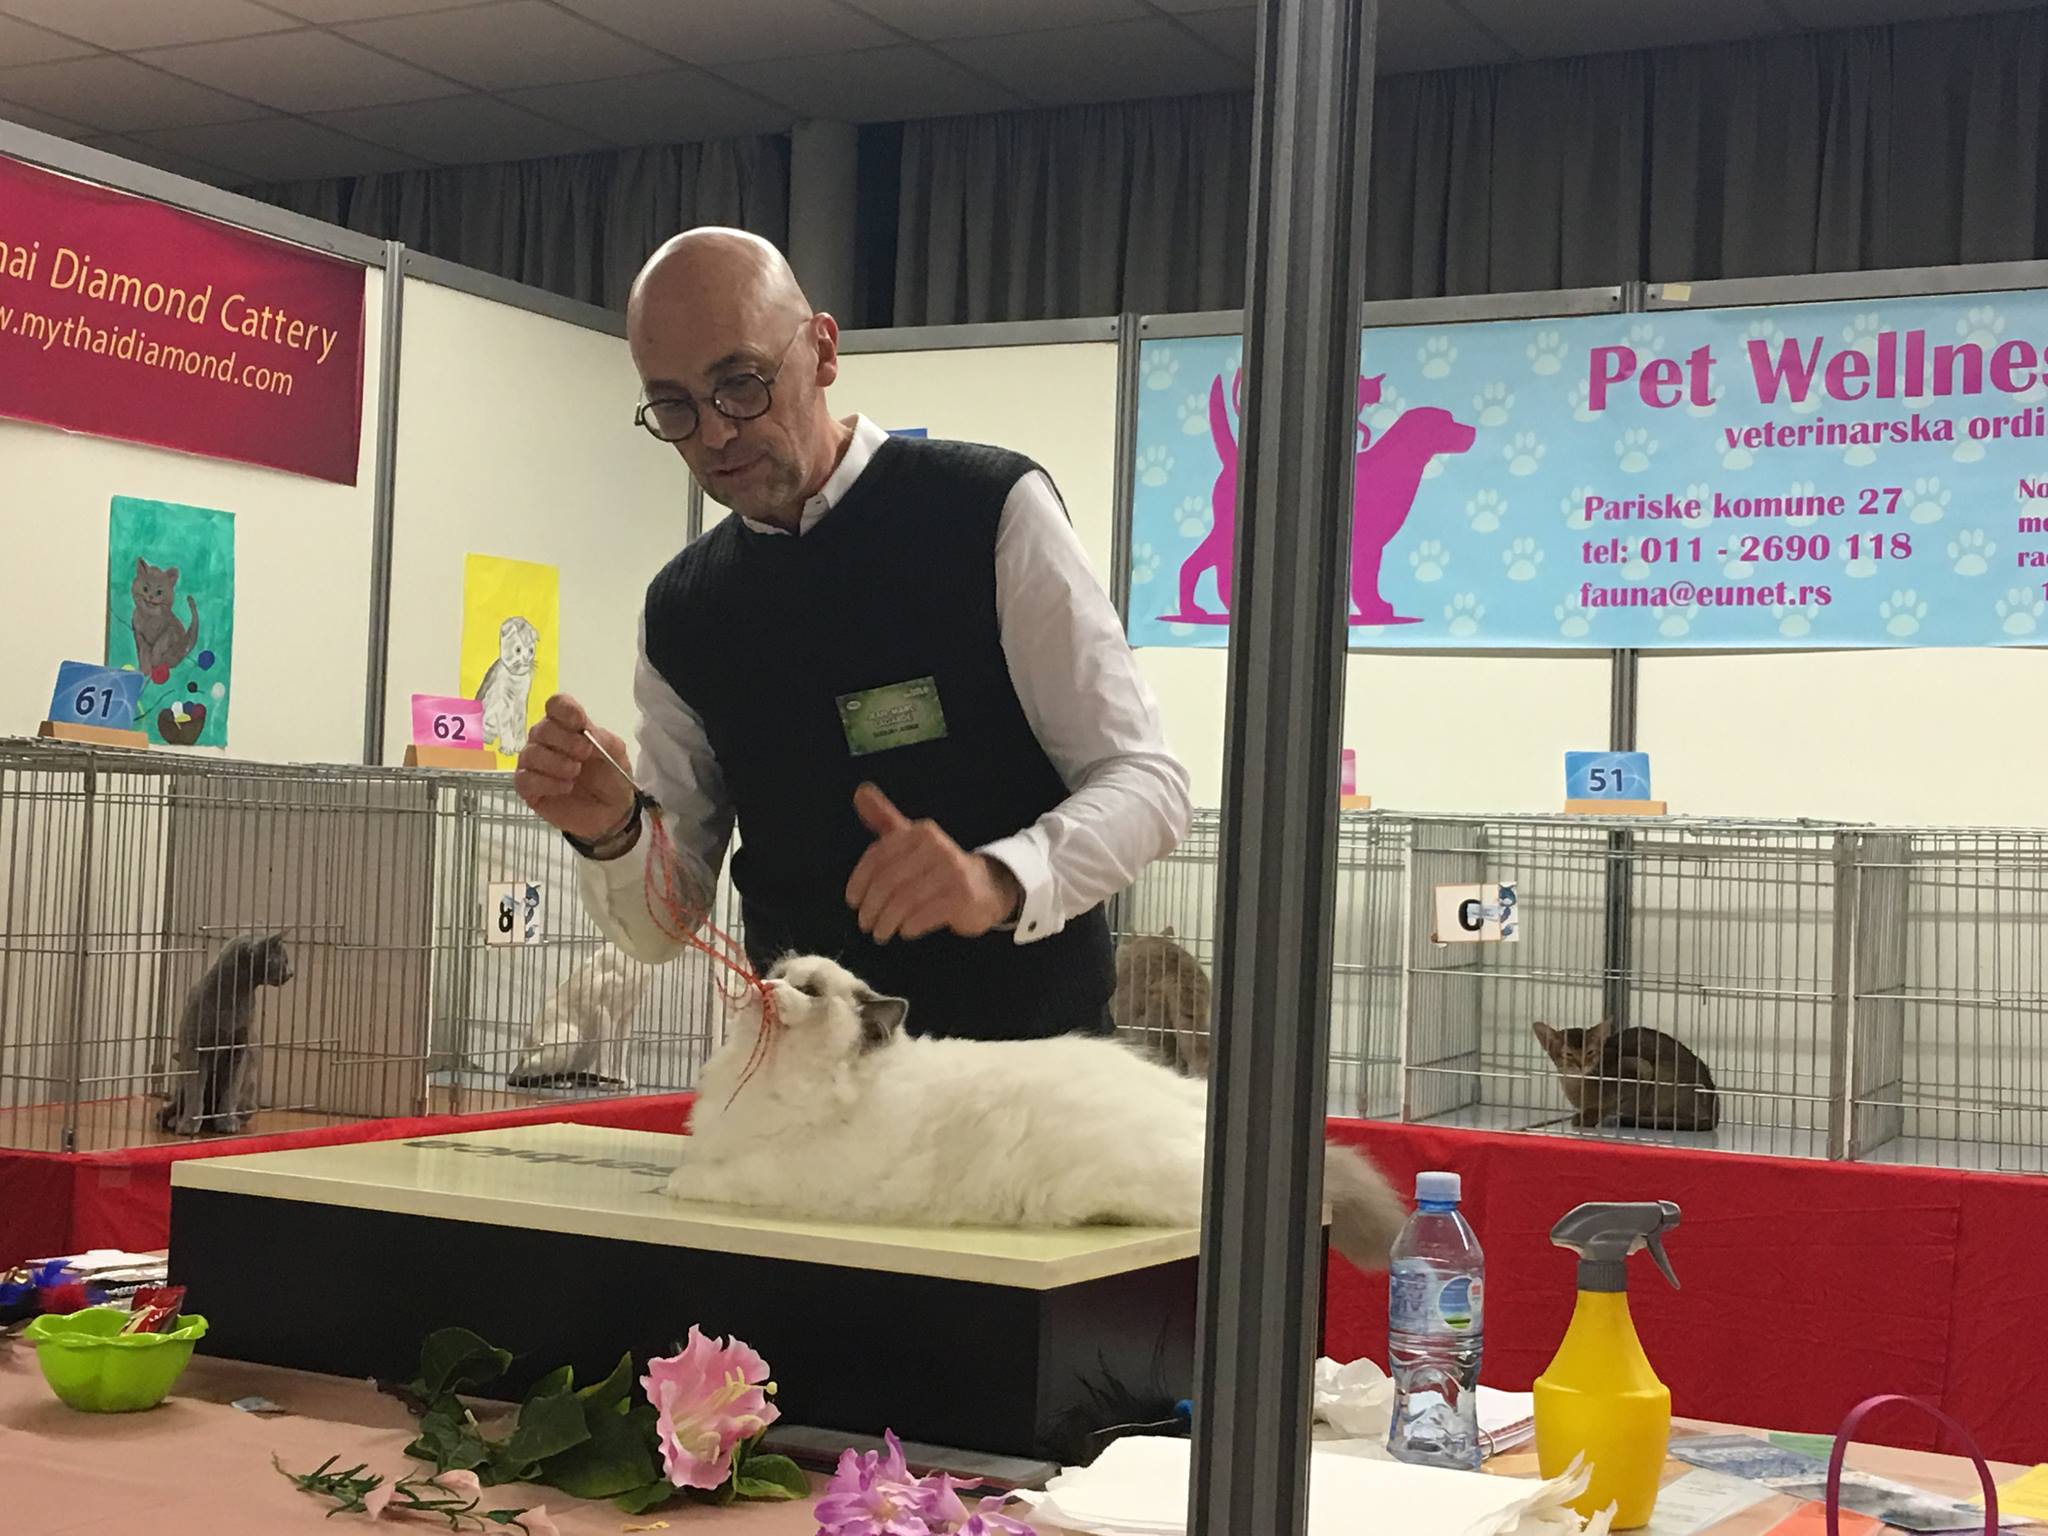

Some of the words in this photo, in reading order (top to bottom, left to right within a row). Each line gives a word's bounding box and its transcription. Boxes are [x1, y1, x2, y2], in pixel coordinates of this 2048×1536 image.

[49, 247, 213, 325] Diamond
[219, 294, 338, 365] Cattery
[1587, 343, 1718, 412] Pet
[1747, 329, 2048, 405] Wellne
[1725, 413, 1955, 450] veterinarska
[1968, 406, 2044, 440] ordi
[1583, 492, 1702, 522] Pariske
[1713, 492, 1846, 519] komune
[1858, 487, 1904, 516] 27
[1582, 539, 1628, 564] tel:
[1640, 536, 1702, 563] 011
[1739, 534, 1831, 562] 2690
[1847, 532, 1913, 561] 118
[2017, 551, 2048, 568] ra
[1580, 581, 1832, 608] fauna@eunet.rs
[75, 686, 113, 718] 61
[434, 715, 466, 741] 62
[1590, 768, 1622, 792] 51
